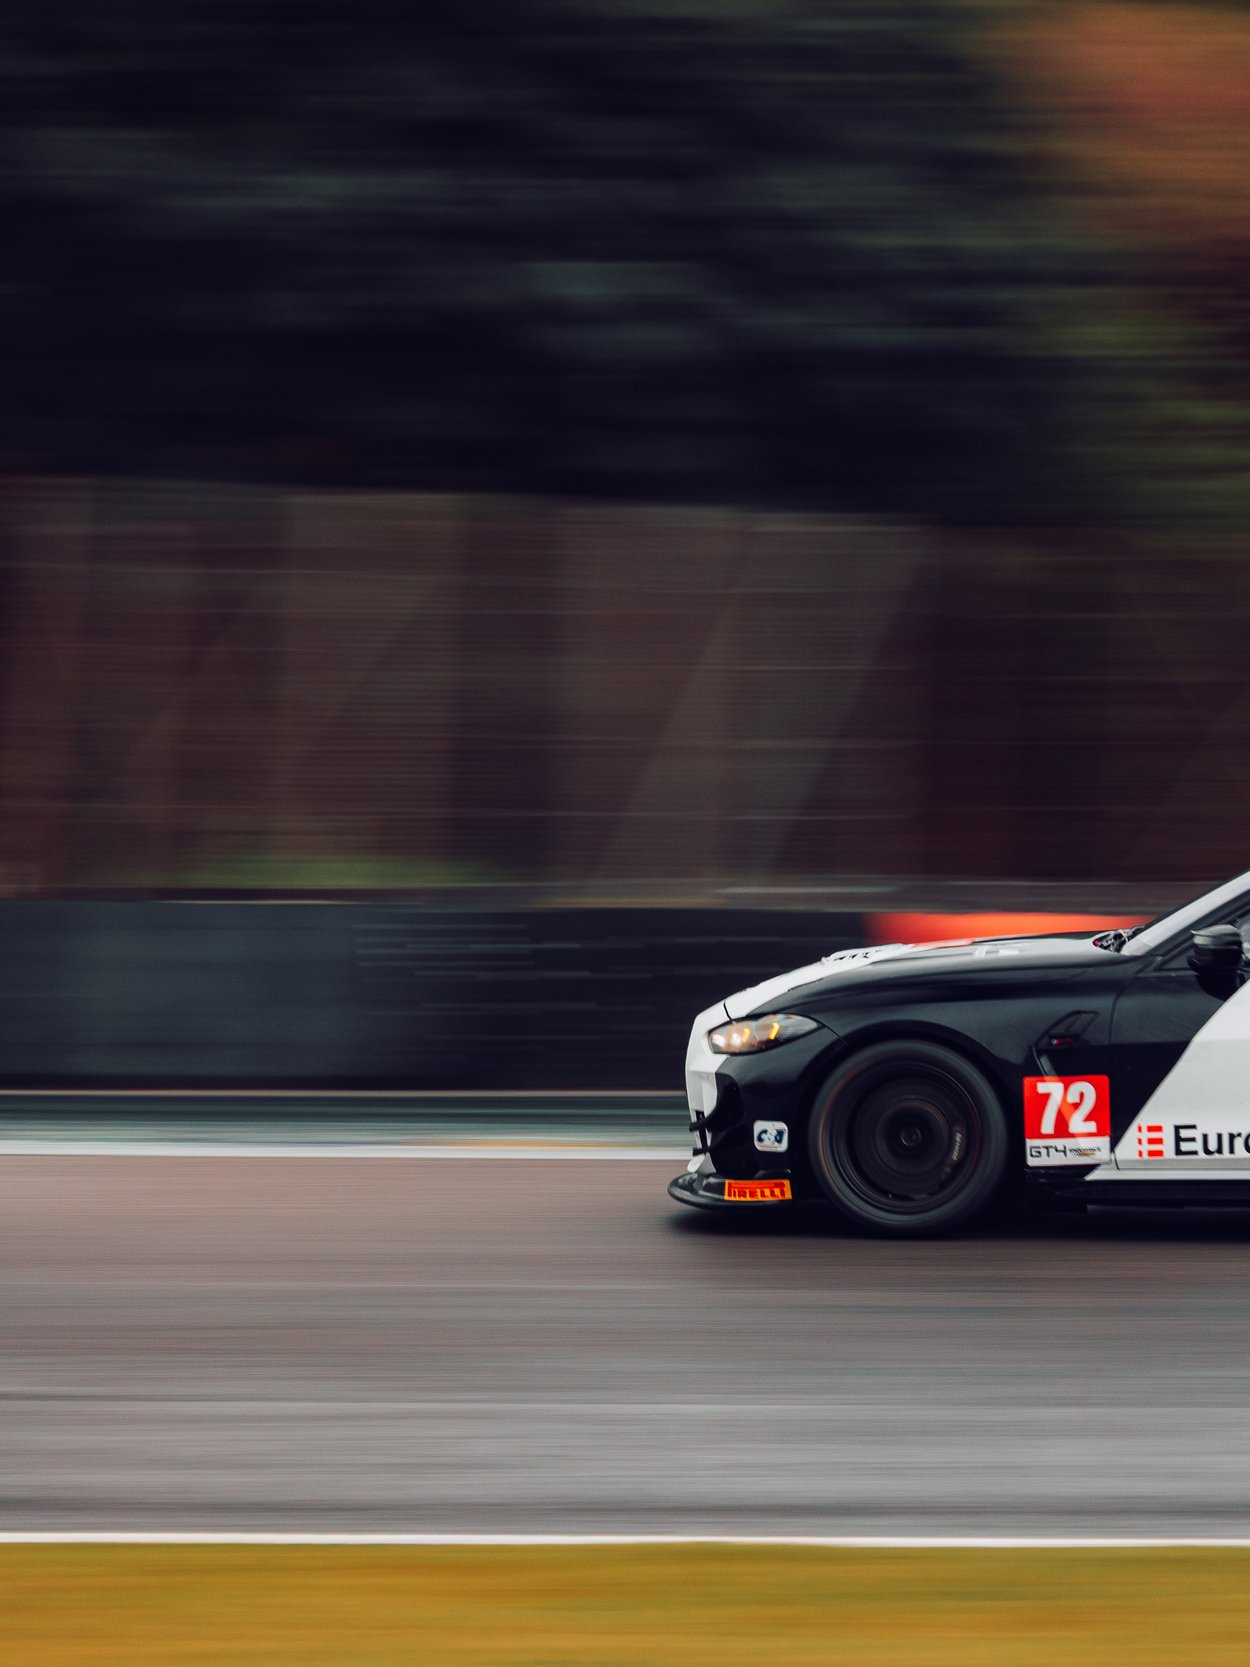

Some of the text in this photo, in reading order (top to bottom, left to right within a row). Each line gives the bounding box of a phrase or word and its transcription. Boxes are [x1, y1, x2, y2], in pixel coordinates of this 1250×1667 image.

[1036, 1081, 1098, 1135] 72
[1030, 1145, 1067, 1158] GT4
[727, 1181, 786, 1198] PIRELLI
